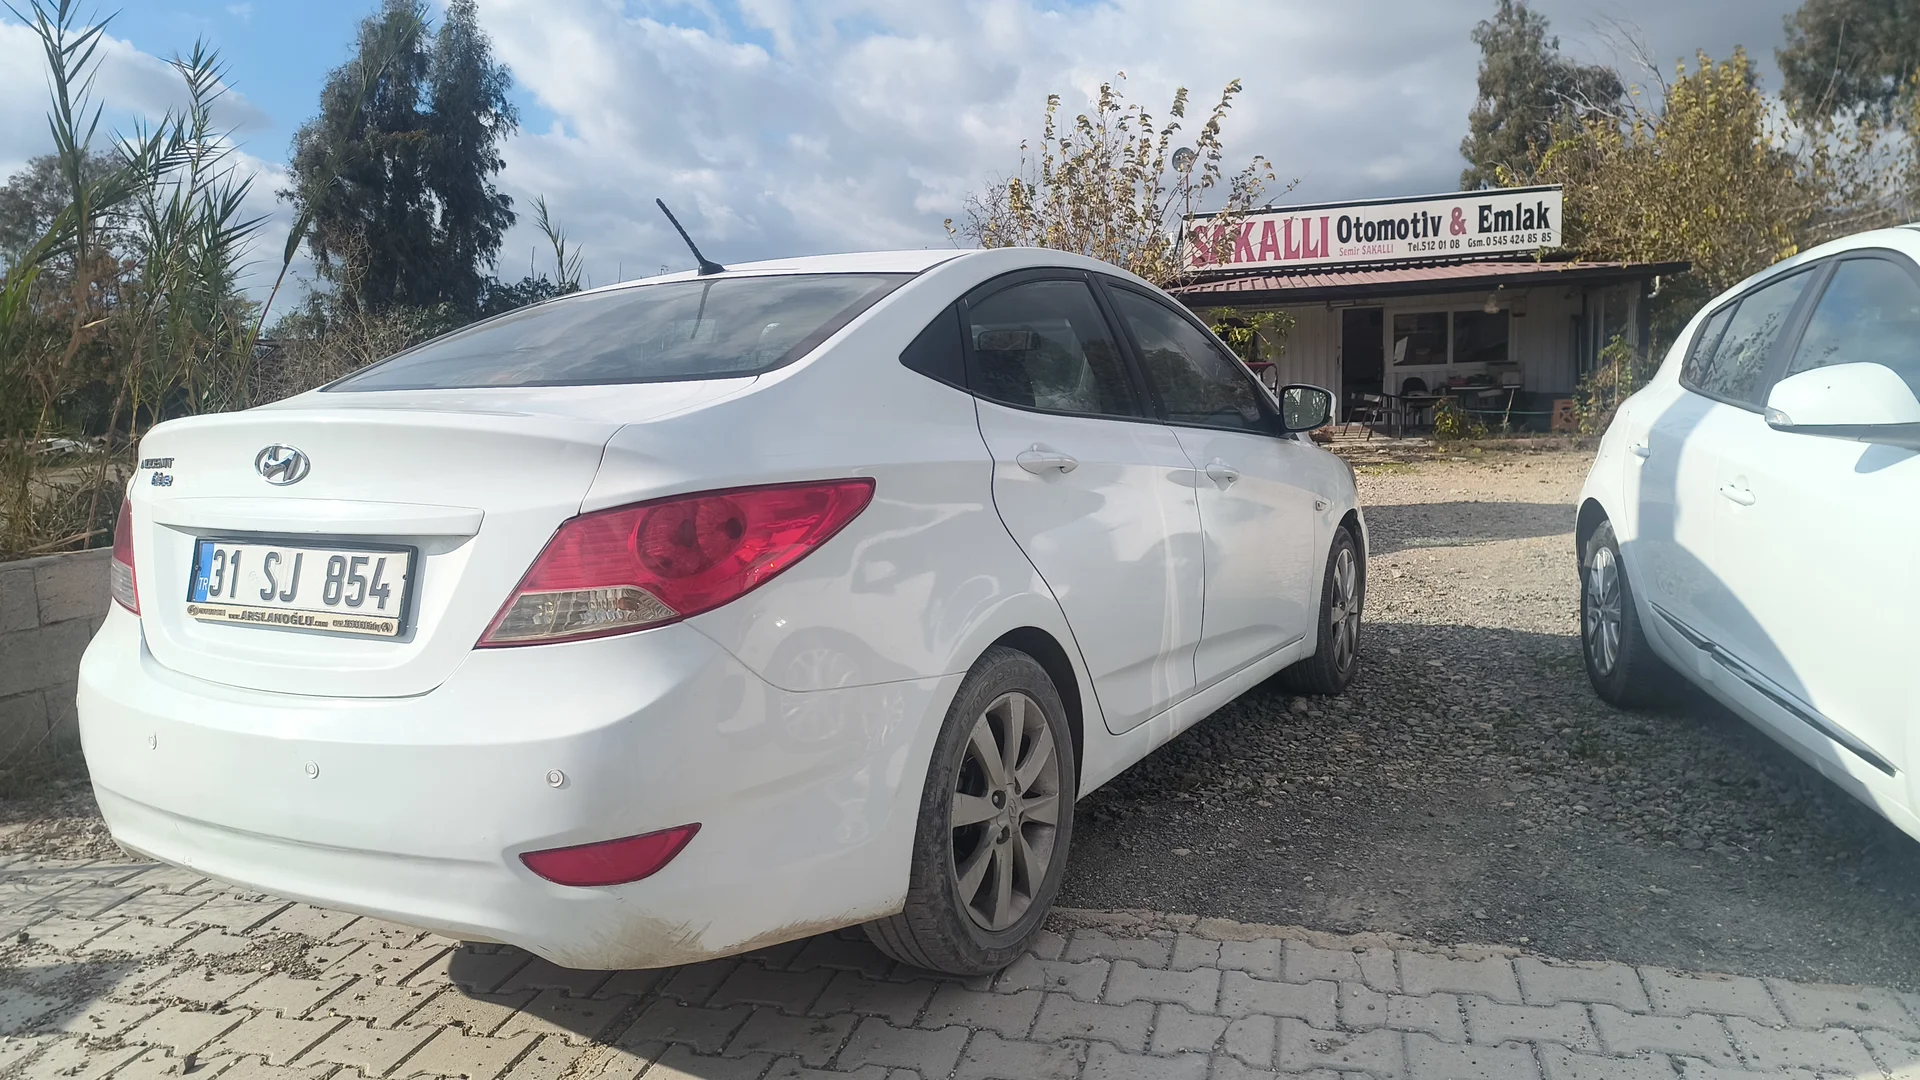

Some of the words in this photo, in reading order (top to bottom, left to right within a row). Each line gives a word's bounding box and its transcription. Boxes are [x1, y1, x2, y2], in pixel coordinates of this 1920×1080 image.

[1192, 216, 1330, 268] SAKALLI
[1337, 210, 1442, 243] Otomotiv
[1449, 207, 1467, 236] &
[1478, 200, 1550, 234] Emlak
[1339, 247, 1360, 257] Semir
[1361, 243, 1394, 255] SAKALLI
[1438, 239, 1447, 250] 01
[1449, 238, 1460, 249] 08
[1509, 234, 1525, 245] 424
[1527, 232, 1538, 243] 85
[1541, 231, 1552, 243] 85
[198, 577, 209, 591] TR
[209, 549, 242, 599] 31
[260, 551, 304, 603] SJ
[323, 555, 390, 610] 854
